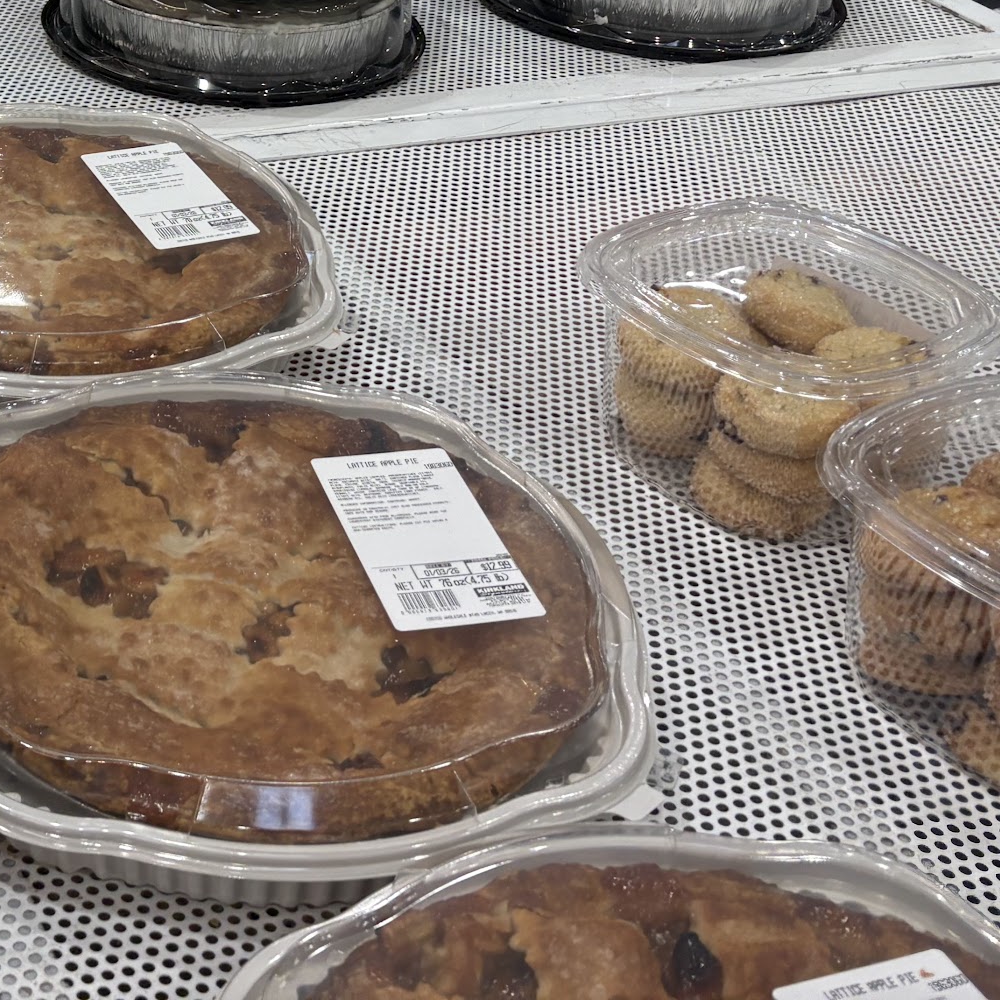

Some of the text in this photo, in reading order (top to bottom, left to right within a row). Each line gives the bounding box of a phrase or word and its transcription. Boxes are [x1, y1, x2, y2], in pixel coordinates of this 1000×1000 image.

[346, 457, 419, 470] LATTICE APPLE PIE
[480, 560, 512, 571] $12.99
[423, 567, 460, 577] 01/03/26
[394, 581, 415, 592] NET
[421, 579, 434, 589] WT
[438, 578, 453, 588] 76
[477, 583, 526, 595] KIRKLAND
[823, 971, 920, 1000] LATTICE APPLE PIE
